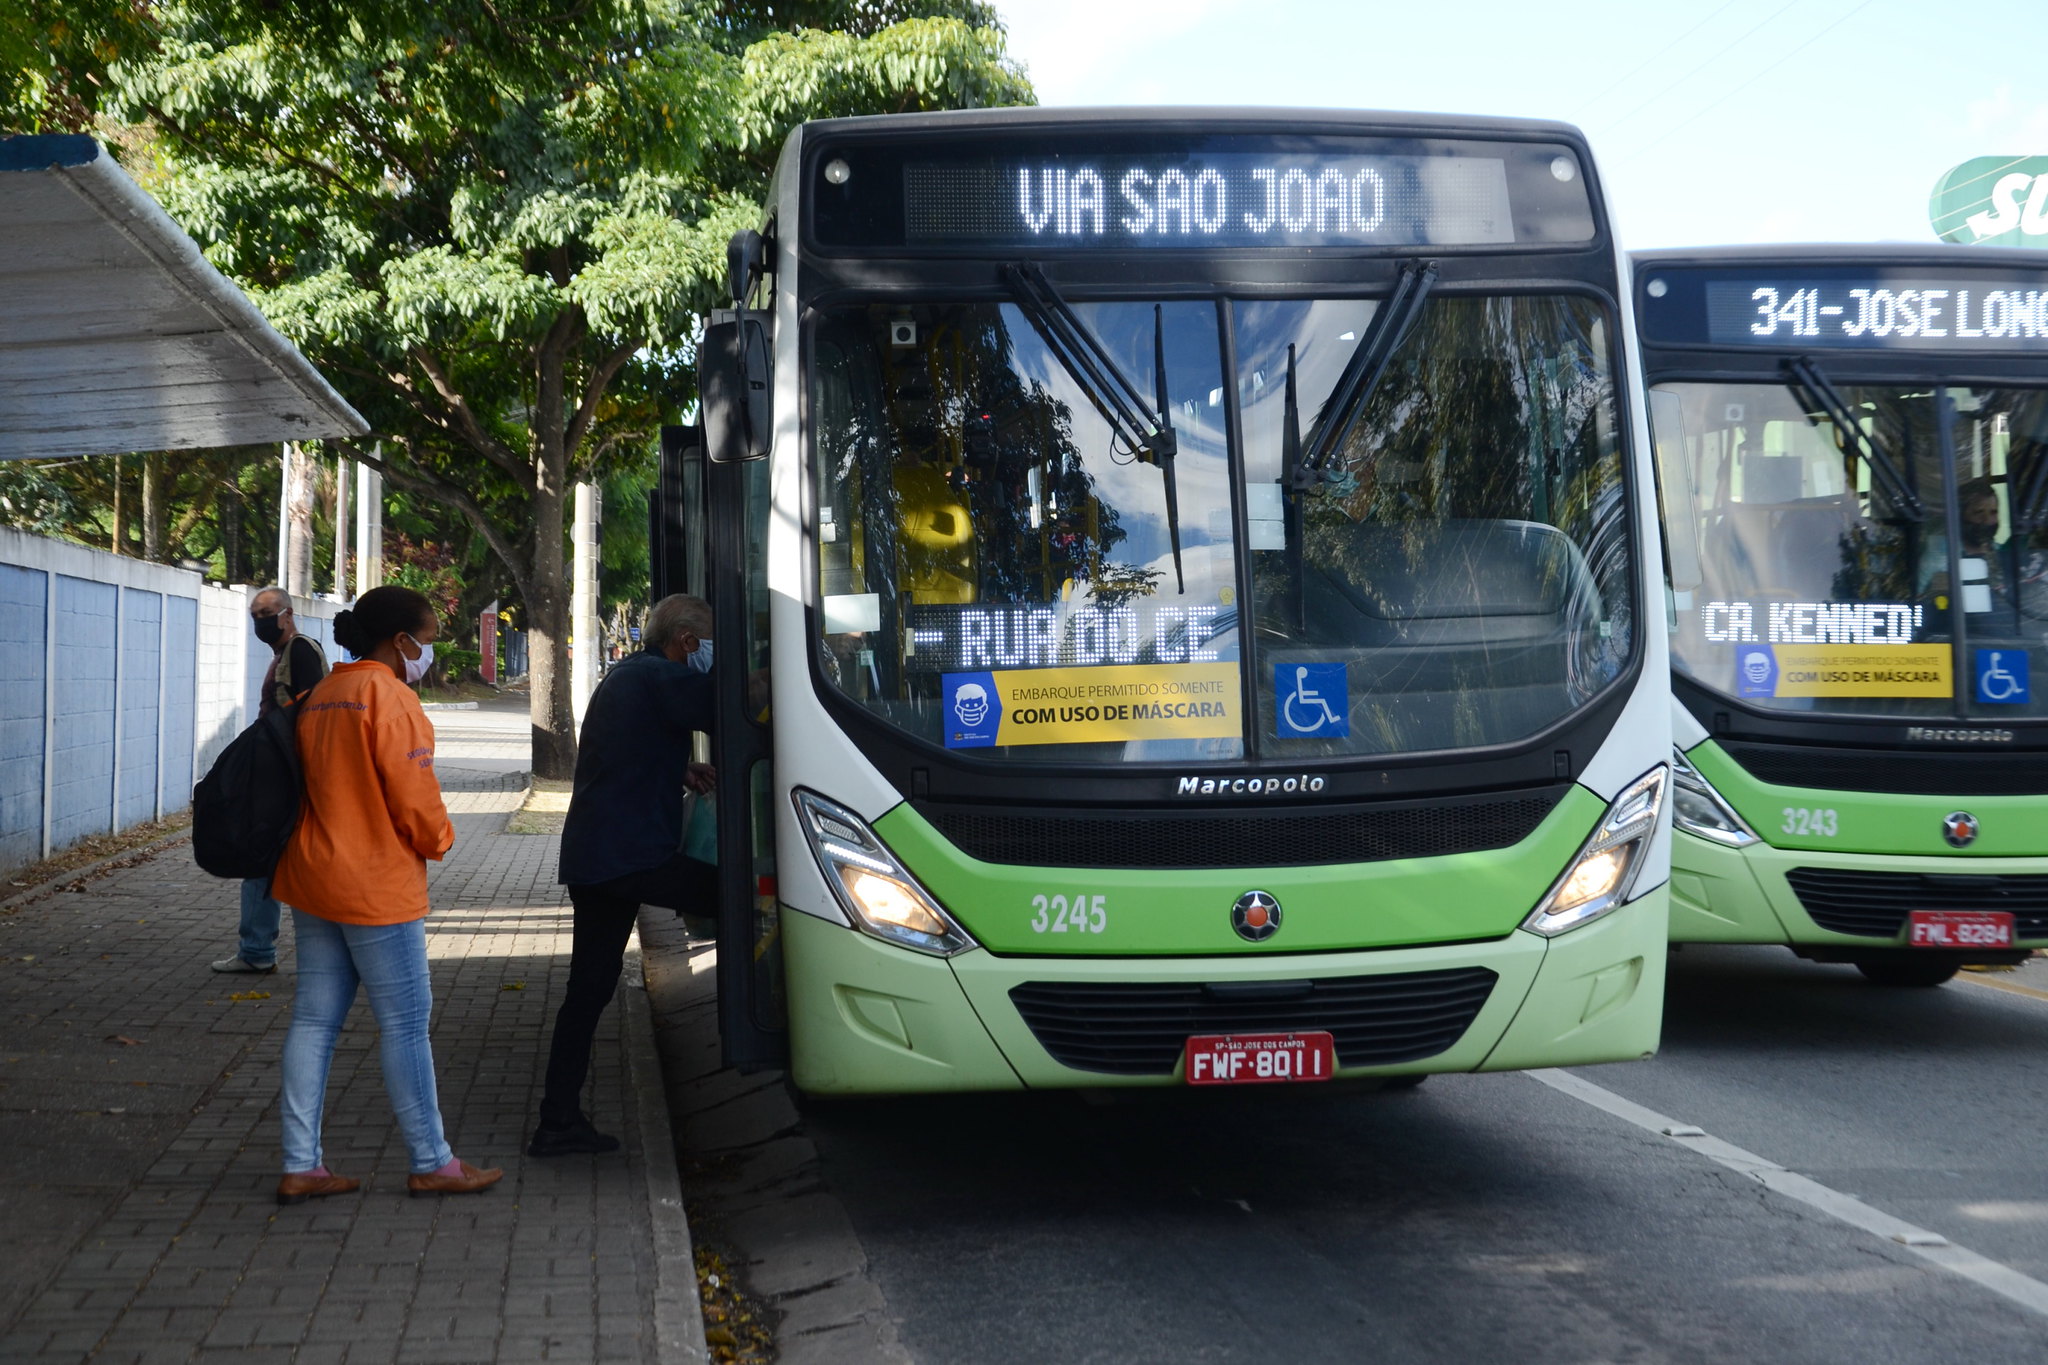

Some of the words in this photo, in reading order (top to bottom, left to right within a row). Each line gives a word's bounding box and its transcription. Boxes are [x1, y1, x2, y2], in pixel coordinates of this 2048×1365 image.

[1019, 168, 1103, 234] VIA
[1121, 168, 1226, 234] SAO
[1244, 168, 1384, 233] JOAO
[1701, 602, 1759, 642] CA.
[961, 608, 1058, 666] RUA
[1075, 606, 1137, 664] DO
[1786, 671, 1818, 683] COM
[1821, 671, 1850, 683] USO
[1852, 671, 1871, 683] DE
[1874, 668, 1940, 683] MÁSCARA
[1012, 685, 1085, 702] EMBARQUE
[1088, 683, 1159, 698] PERMITIDO
[1161, 681, 1224, 696] SOMENTE
[1012, 708, 1056, 725] COM
[1060, 705, 1100, 723] USO
[1103, 704, 1128, 721] DE
[1132, 700, 1226, 720] MÁSCARA
[1906, 727, 2014, 742] Marcopolo
[1177, 774, 1325, 795] Marcopolo
[1781, 807, 1838, 837] 3243
[1031, 894, 1106, 933] 3245
[1278, 1040, 1306, 1049] CAMPOS
